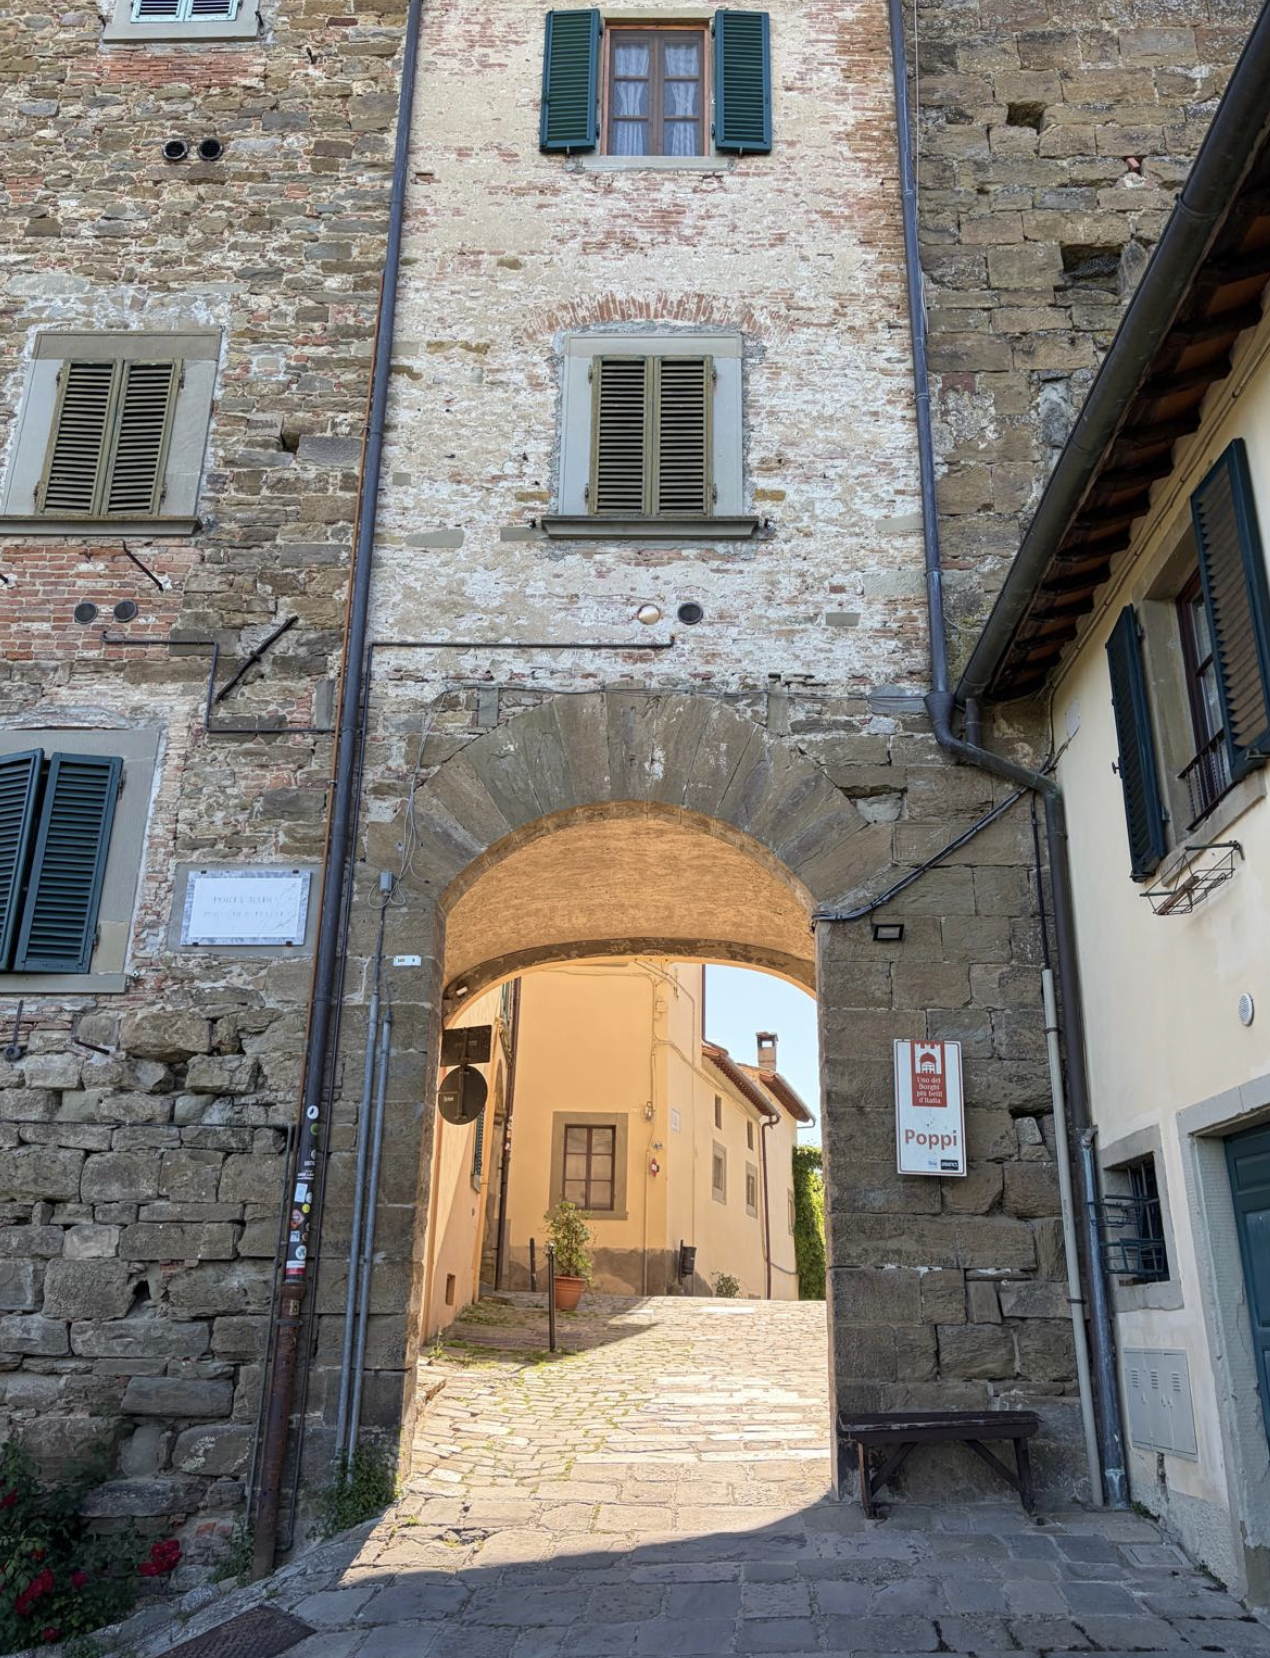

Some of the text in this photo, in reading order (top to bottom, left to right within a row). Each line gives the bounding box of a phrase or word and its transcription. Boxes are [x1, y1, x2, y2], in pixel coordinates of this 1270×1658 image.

[930, 1076, 941, 1084] dei
[918, 1083, 940, 1091] Borghi
[928, 1090, 943, 1098] belli
[905, 1129, 957, 1150] Poppi
